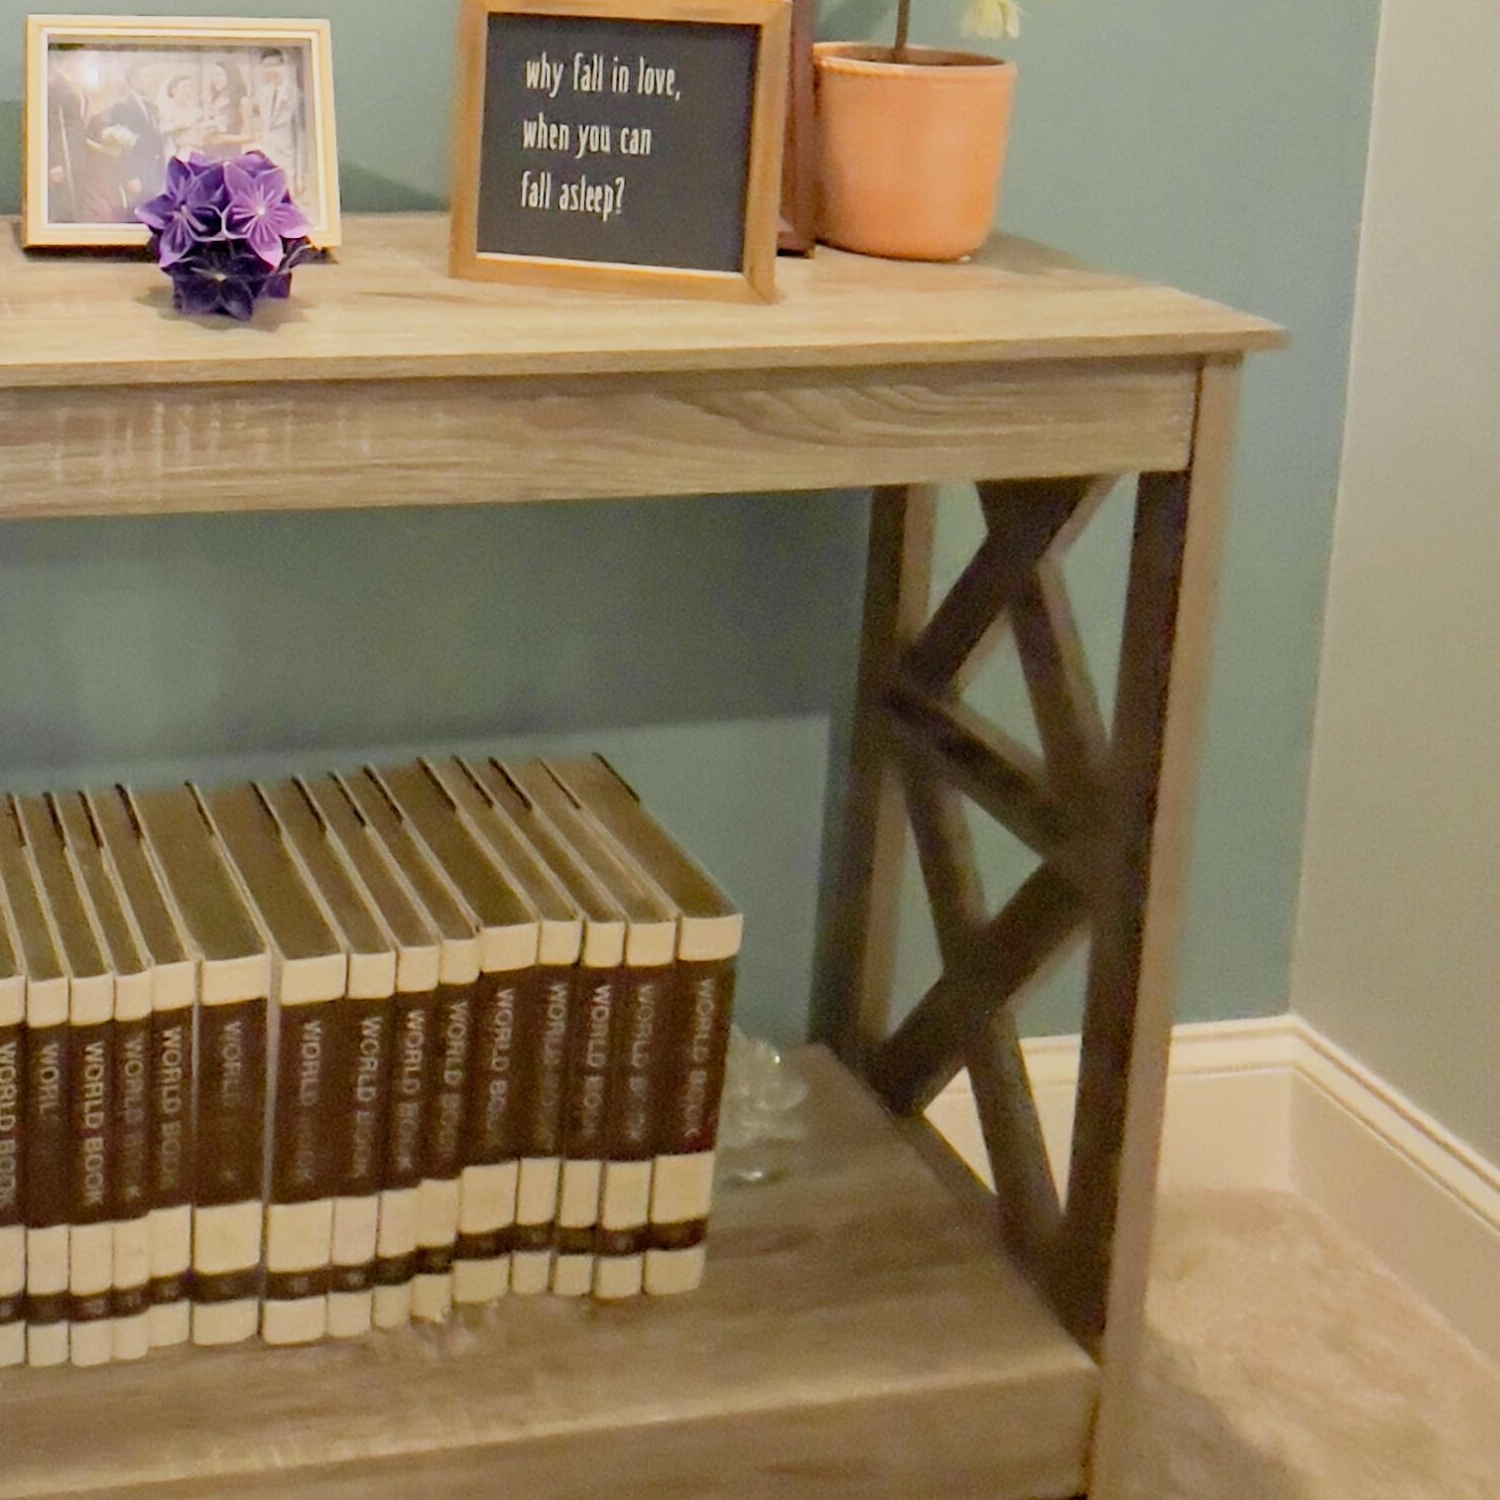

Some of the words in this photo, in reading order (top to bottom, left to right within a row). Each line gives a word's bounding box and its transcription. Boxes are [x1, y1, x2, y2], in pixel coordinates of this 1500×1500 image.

[525, 52, 564, 99] why
[572, 52, 604, 93] fall
[611, 56, 630, 94] in
[637, 56, 682, 101] love,
[522, 112, 570, 152] when
[577, 126, 611, 160] you
[619, 126, 652, 156] can
[520, 171, 552, 210] fall
[558, 175, 626, 222] asleep?
[161, 1024, 184, 1116] WORLD
[299, 1020, 322, 1108] WORLD
[356, 1015, 383, 1103] WORLD
[400, 1008, 426, 1096] WORLD
[442, 1000, 469, 1088] WORLD
[489, 986, 517, 1073] WORLD
[585, 983, 612, 1070] WORLD
[83, 1040, 106, 1129] WORLD
[83, 1135, 106, 1206] BOOK
